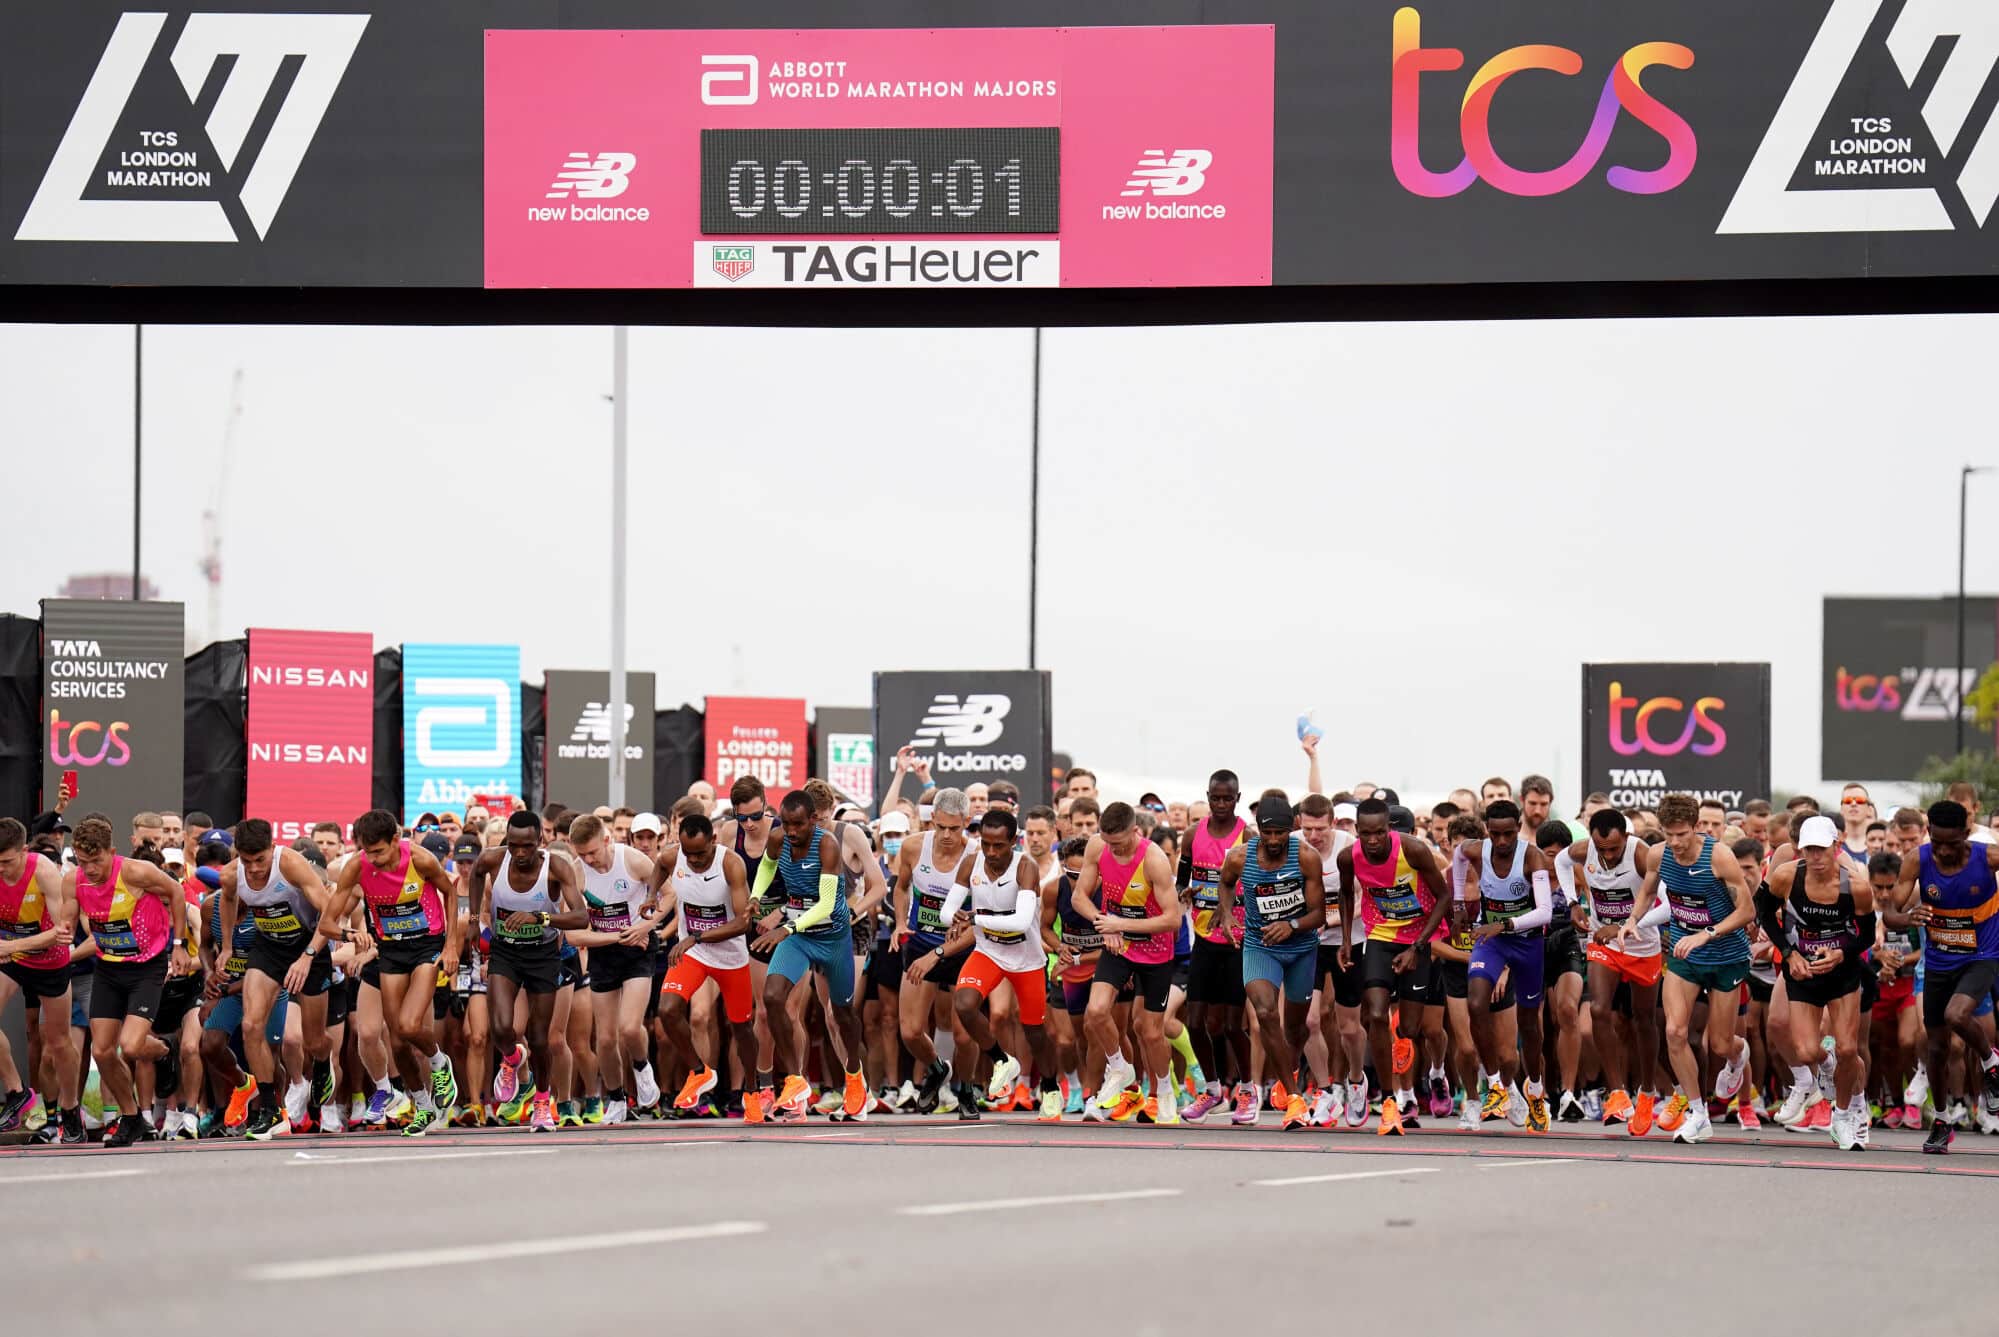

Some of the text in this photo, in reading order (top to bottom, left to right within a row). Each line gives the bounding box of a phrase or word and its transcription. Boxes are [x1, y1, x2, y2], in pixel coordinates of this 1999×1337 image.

[769, 60, 847, 78] ABBOTT
[768, 79, 1058, 99] WORLD MARATHON MAJORS
[1391, 6, 1698, 198] tcs
[1850, 117, 1892, 134] TCS
[140, 131, 178, 147] TCS
[1829, 136, 1912, 155] LONDON
[120, 150, 198, 168] LONDON
[1814, 157, 1927, 176] MARATHON
[107, 169, 212, 188] MARATHON
[727, 159, 1022, 218] 00:00:01
[528, 203, 651, 222] new balance
[1102, 200, 1226, 221] new balance
[719, 249, 750, 259] TAG
[715, 261, 752, 278] HEUER
[50, 640, 102, 657] TATA
[50, 661, 169, 680] CONSULTANCY
[252, 667, 369, 689] NISSAN
[50, 681, 127, 699] SERVICES
[1835, 665, 1902, 712] tcs
[1608, 681, 1727, 756] tcs
[50, 708, 131, 767] tcs
[251, 743, 368, 764] NISSAN
[558, 743, 643, 760] new balce
[717, 740, 793, 758] LONDON
[833, 743, 873, 763] TA
[937, 751, 1027, 772] balance
[717, 758, 793, 789] PRIDE
[1609, 769, 1667, 787] TATA
[1609, 789, 1743, 809] CONSANCY
[1200, 886, 1219, 898] ACE
[1262, 893, 1300, 911] LEMMA
[1802, 906, 1840, 916] KIPRUN
[387, 920, 413, 930] PACE
[99, 937, 131, 946] PACE 4
